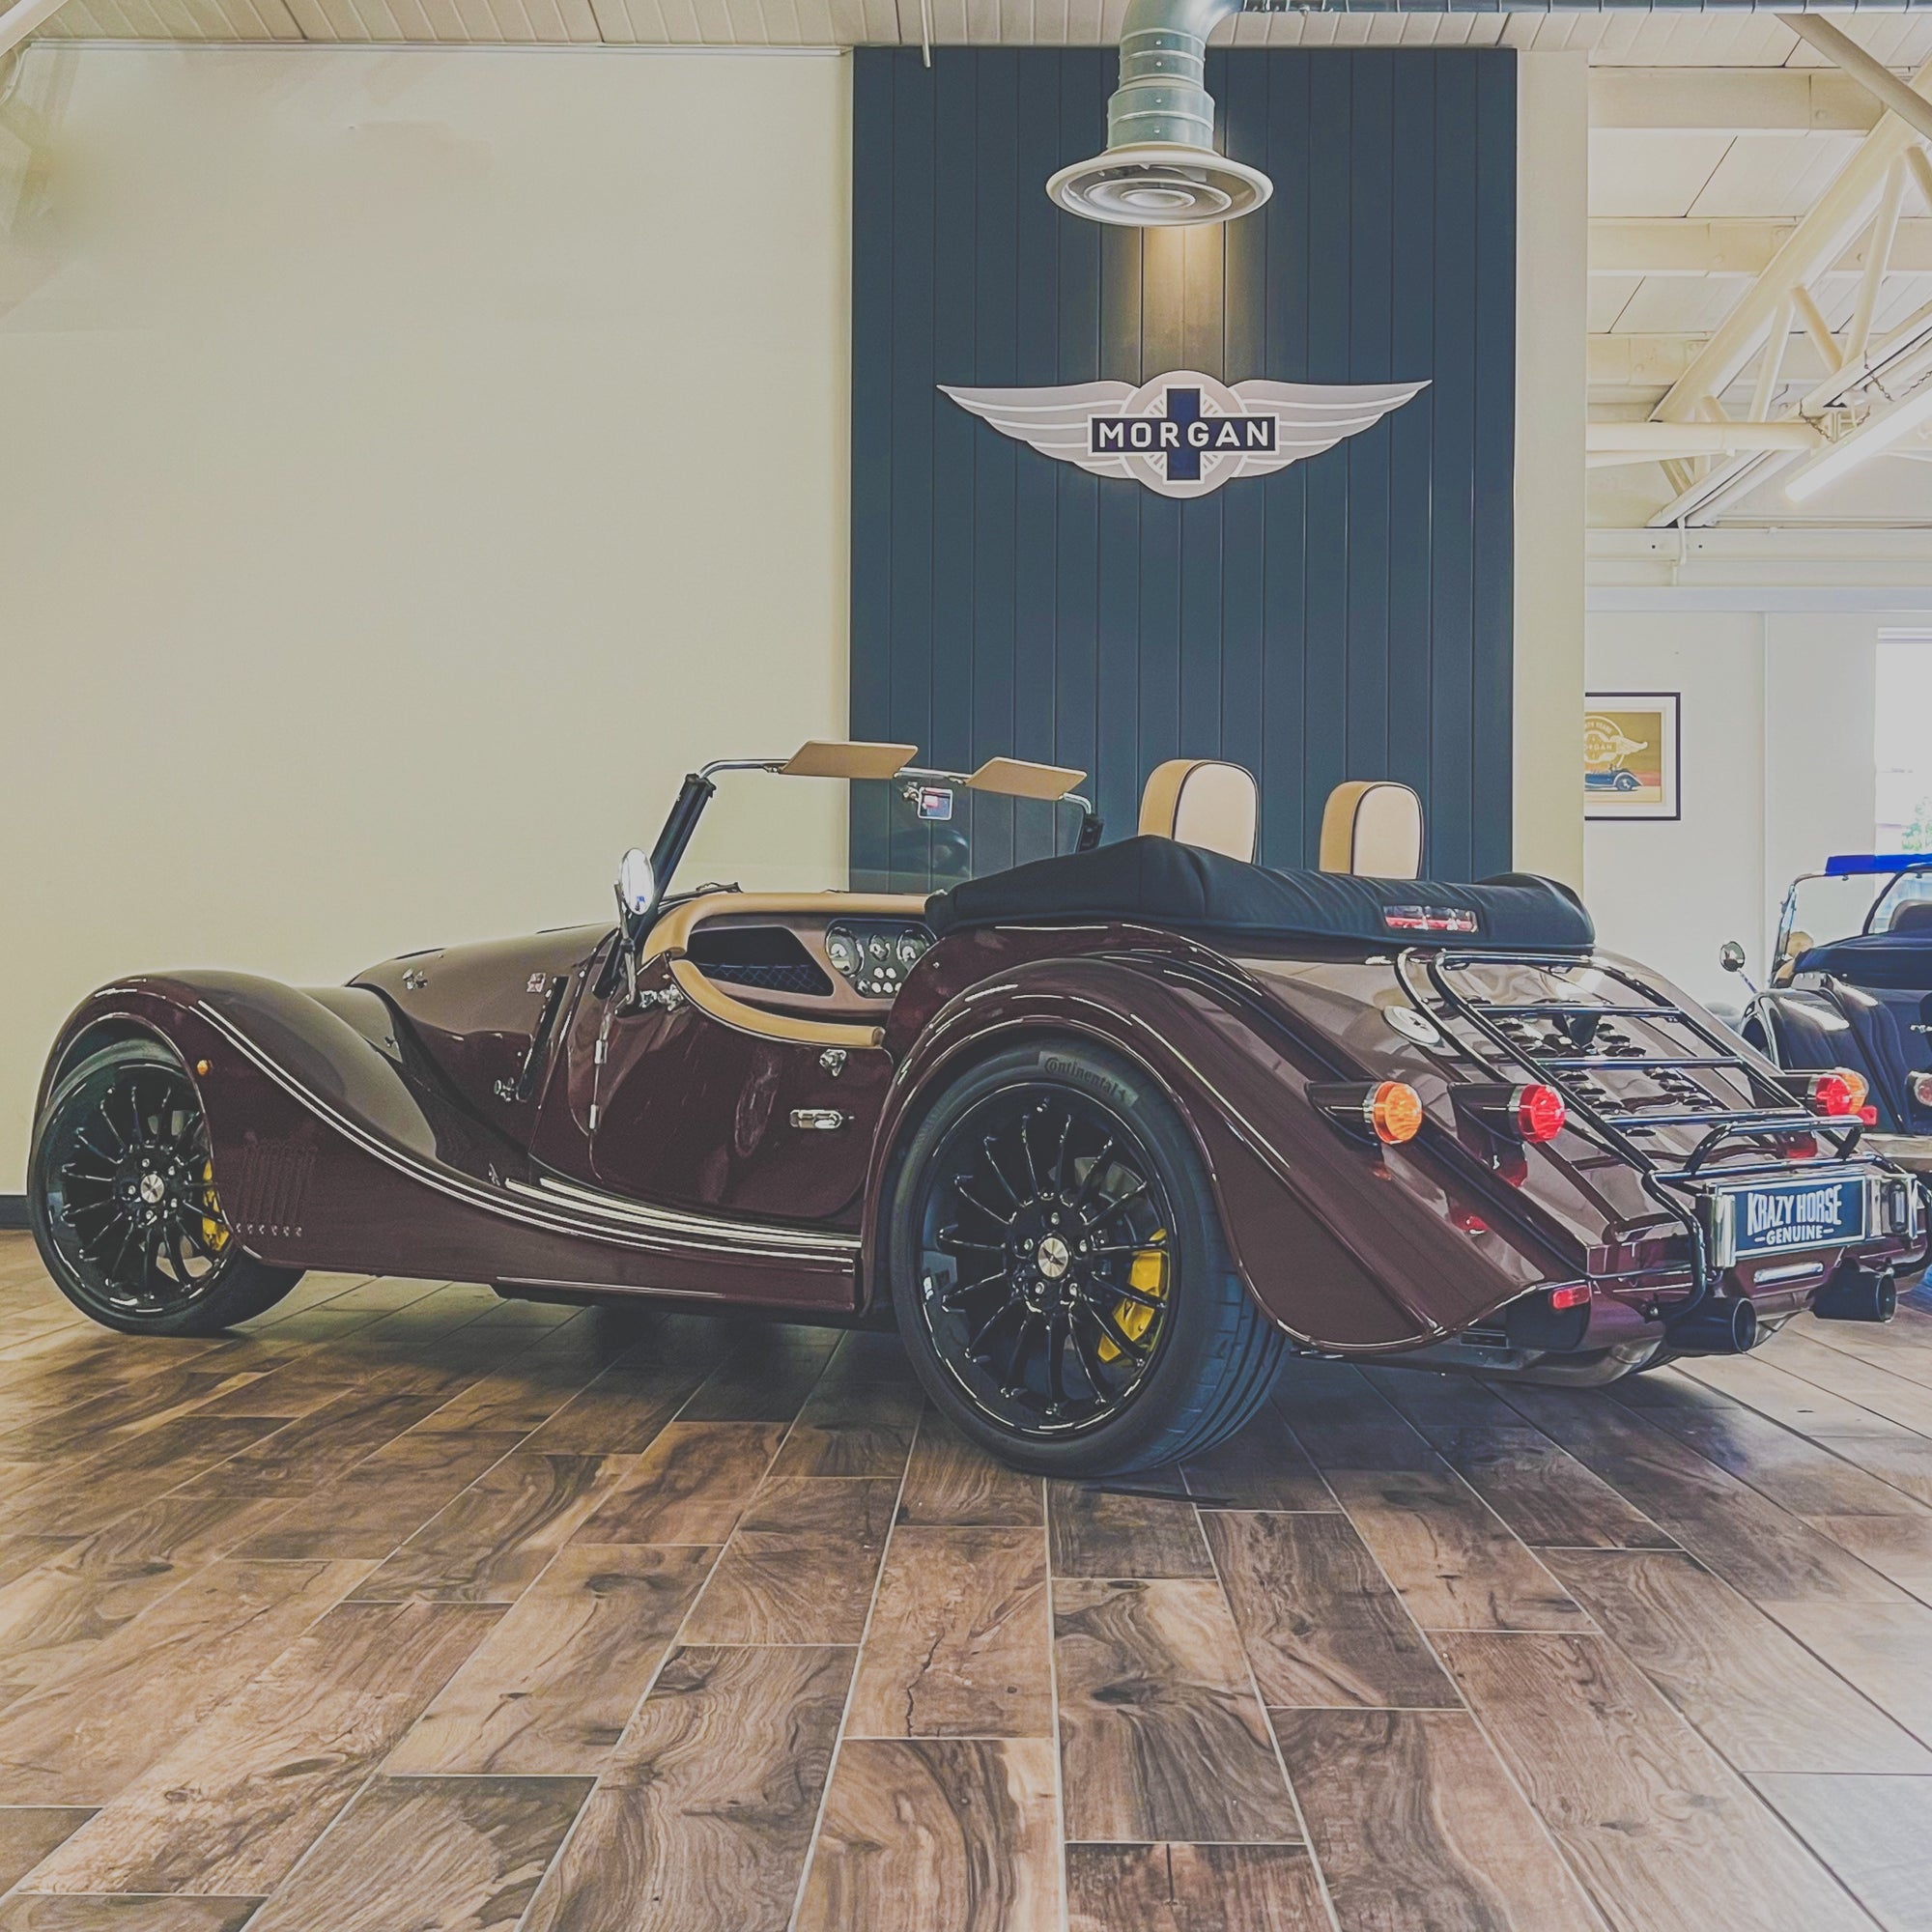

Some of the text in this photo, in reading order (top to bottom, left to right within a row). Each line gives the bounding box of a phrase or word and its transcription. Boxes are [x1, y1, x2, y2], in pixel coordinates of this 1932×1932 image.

[1098, 420, 1270, 448] MORGAN
[1043, 1056, 1120, 1097] Continental
[1747, 1183, 1843, 1236] KRAZY HORSE
